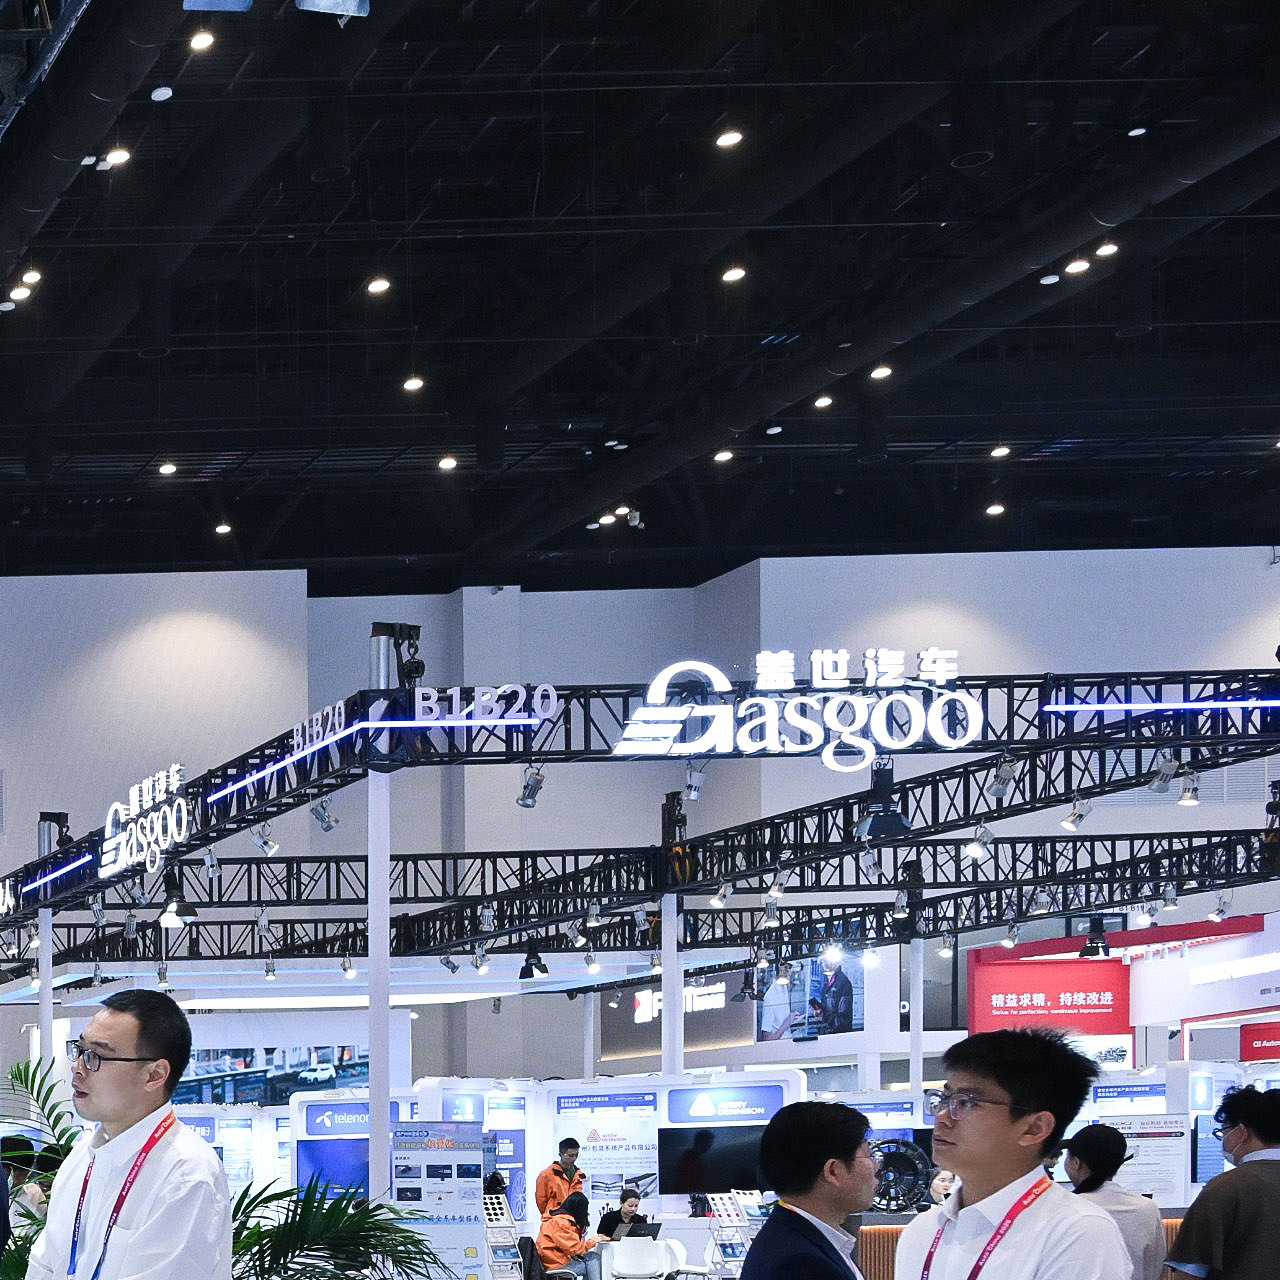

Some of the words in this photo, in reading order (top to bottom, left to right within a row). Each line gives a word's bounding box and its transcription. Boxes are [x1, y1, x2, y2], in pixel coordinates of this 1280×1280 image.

[755, 647, 959, 690] 盖世汽车
[292, 701, 346, 752] B1B20
[414, 684, 558, 721] B1B20
[612, 660, 984, 773] Gasgoo
[98, 797, 188, 879] Gasgoo
